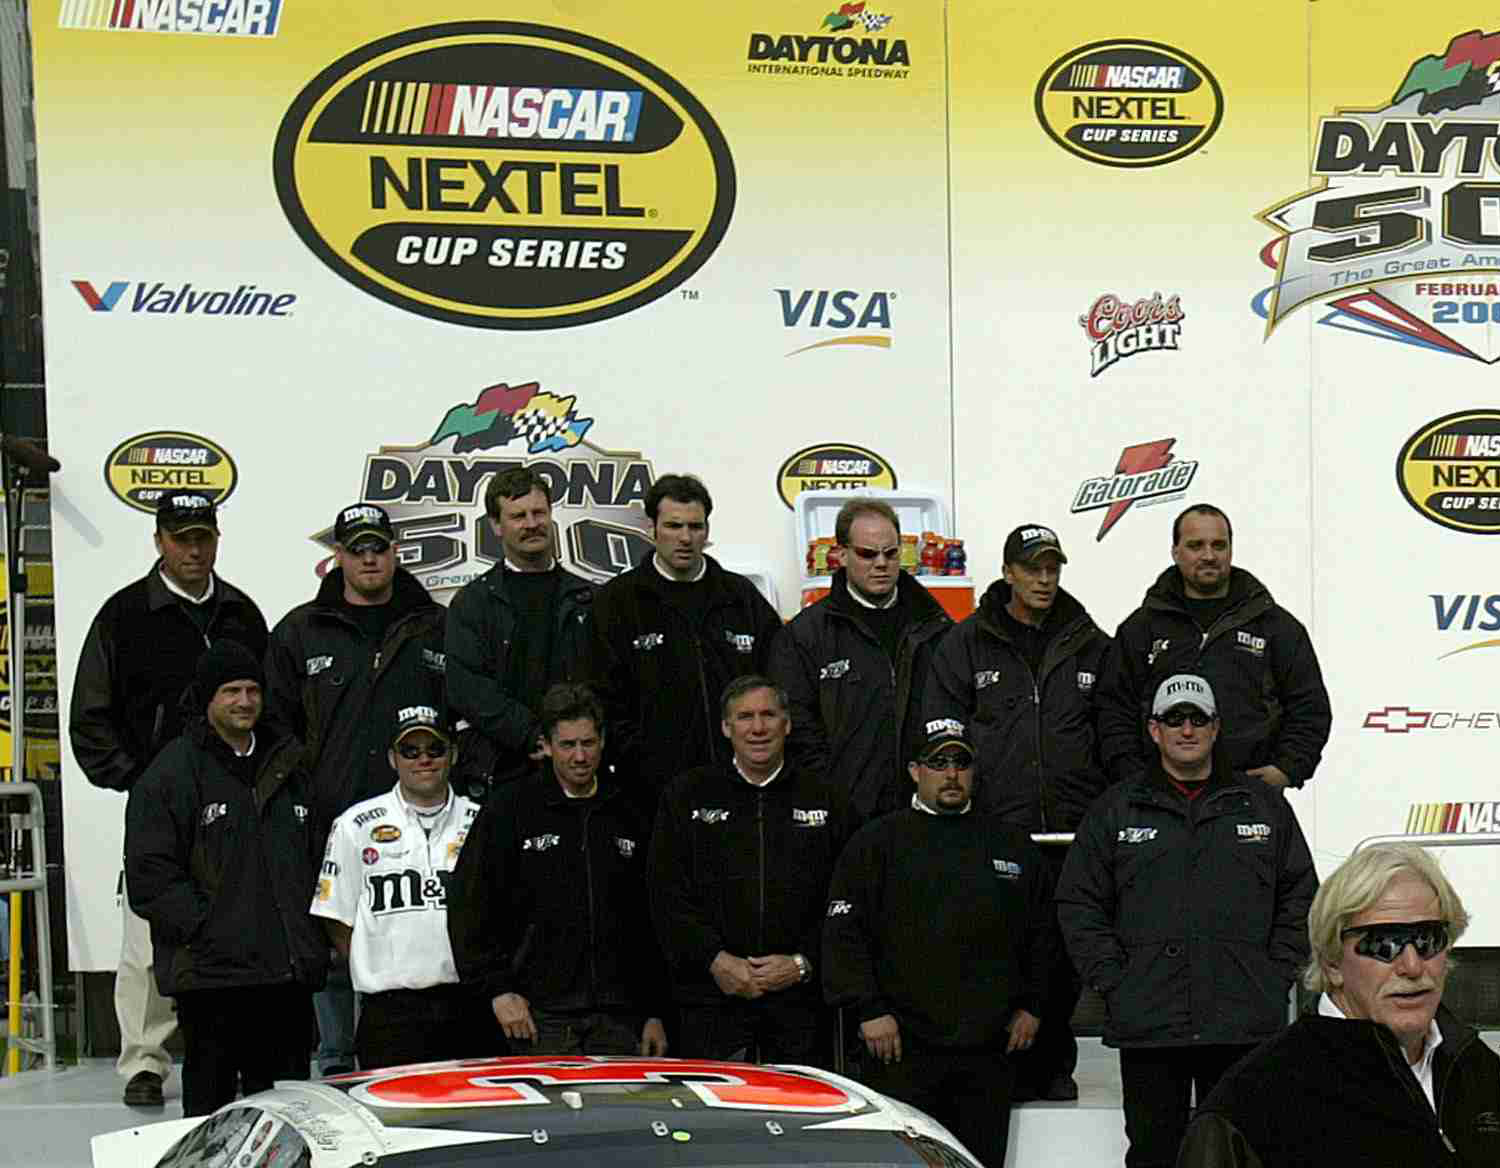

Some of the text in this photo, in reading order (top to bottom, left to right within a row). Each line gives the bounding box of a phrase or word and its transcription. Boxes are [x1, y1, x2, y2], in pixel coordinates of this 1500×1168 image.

[130, 0, 272, 34] NASCAR
[748, 34, 910, 66] DAYTONA
[747, 64, 910, 79] INTERNATIONAL SPEEDWAY
[1105, 65, 1183, 89] NASCAR
[449, 87, 633, 141] NASCAR
[1073, 96, 1187, 121] NEXTEL
[1082, 127, 1179, 144] CUP SERIES
[370, 156, 645, 217] NEXTEL
[397, 236, 627, 270] CUP SERIES
[1327, 267, 1378, 287] The
[1384, 253, 1452, 275] Great
[129, 281, 297, 317] Valvoline
[775, 289, 893, 329] VISA
[1081, 294, 1185, 334] Coors
[1091, 322, 1183, 377] LIGHT
[153, 447, 207, 465] NASCAR
[820, 459, 872, 475] NASCAR
[130, 470, 211, 487] NEXTEL
[138, 489, 163, 500] CUP
[1079, 464, 1194, 506] Gatorade
[1441, 496, 1474, 511] CUP
[391, 512, 657, 577] 50
